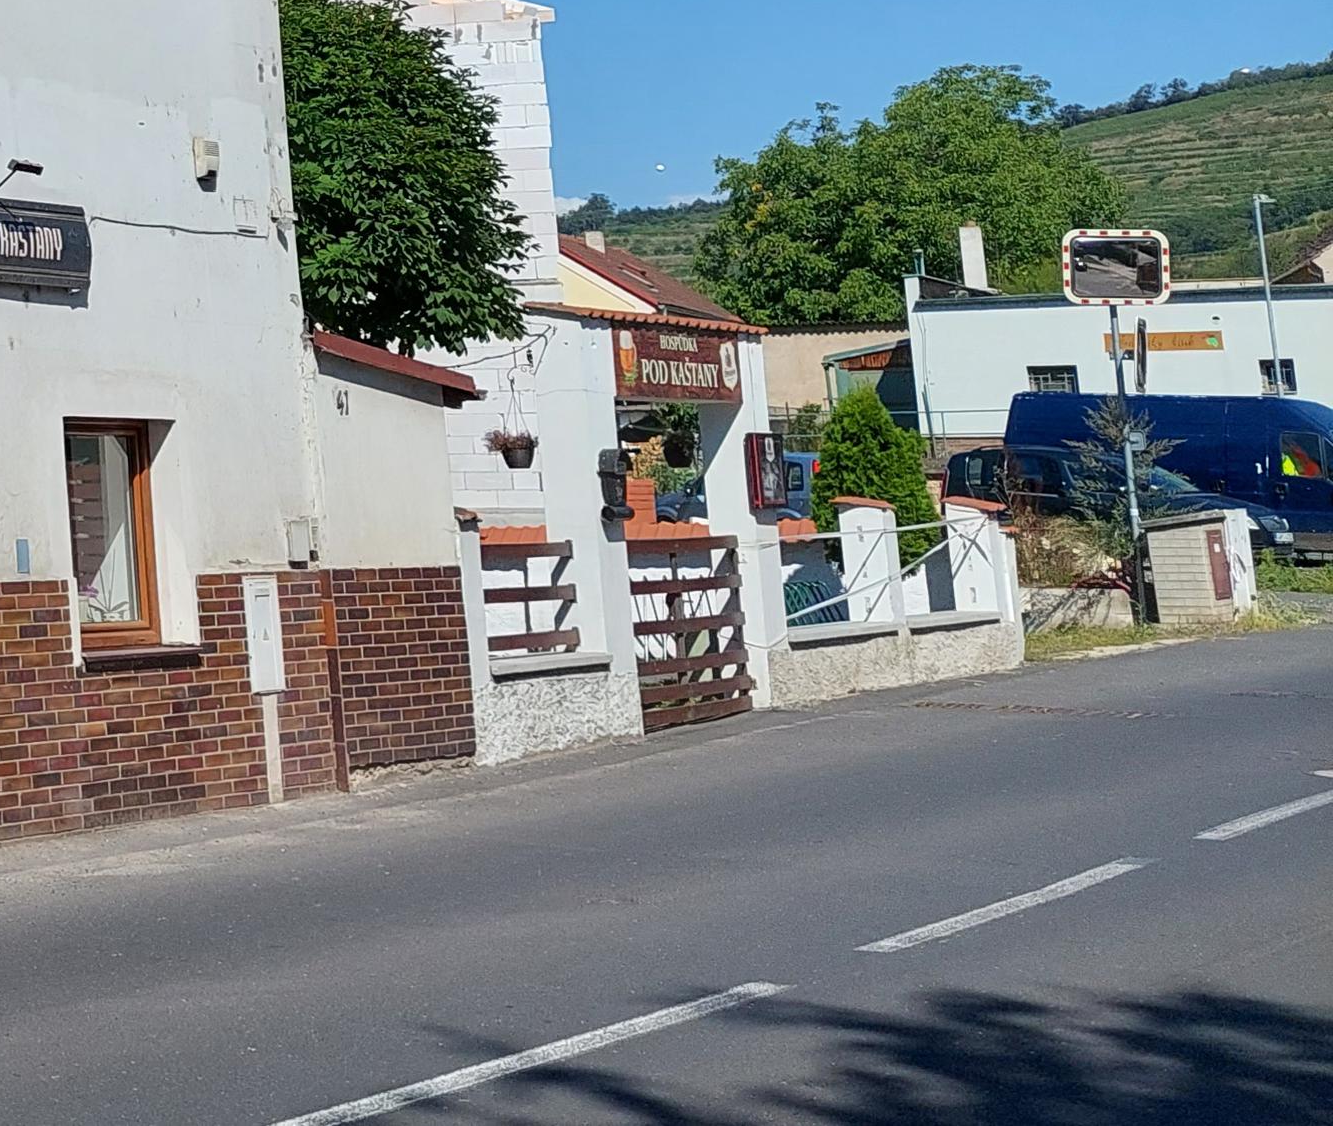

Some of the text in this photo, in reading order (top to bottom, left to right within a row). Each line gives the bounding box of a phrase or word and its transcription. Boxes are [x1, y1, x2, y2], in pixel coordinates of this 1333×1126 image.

[659, 334, 699, 353] HOSPŮDKA
[640, 358, 669, 385] POD
[670, 356, 720, 388] KAŠTANY
[336, 389, 349, 416] 41
